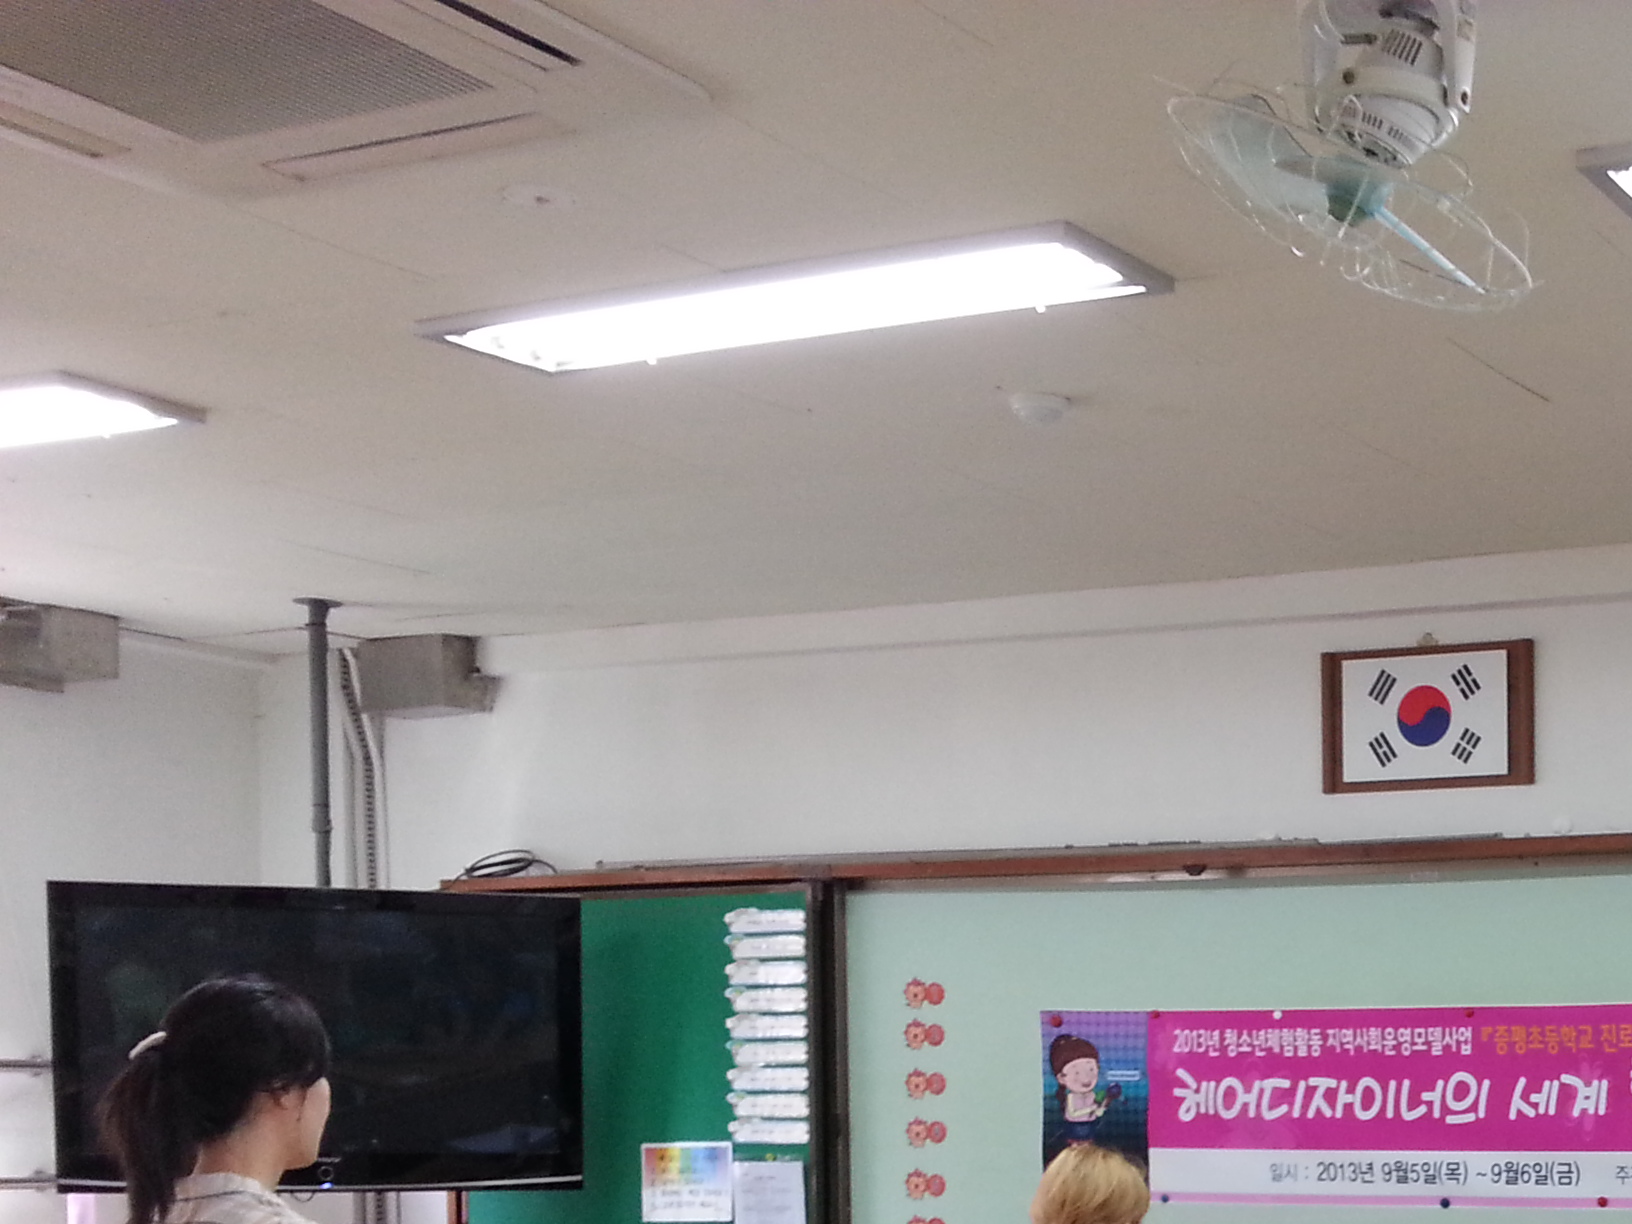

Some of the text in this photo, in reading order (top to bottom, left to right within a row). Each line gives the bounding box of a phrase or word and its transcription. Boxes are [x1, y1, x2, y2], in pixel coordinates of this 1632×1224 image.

[1173, 1028, 1220, 1057] 2013년
[1224, 1028, 1323, 1057] 청소년체험활동
[1326, 1026, 1473, 1056] 지역사회운영모델사업
[1173, 1067, 1491, 1125] 헤어디자이너의
[1508, 1073, 1609, 1121] 세계
[1316, 1160, 1375, 1184] 2013년
[1381, 1159, 1469, 1186] 9월5일(목)
